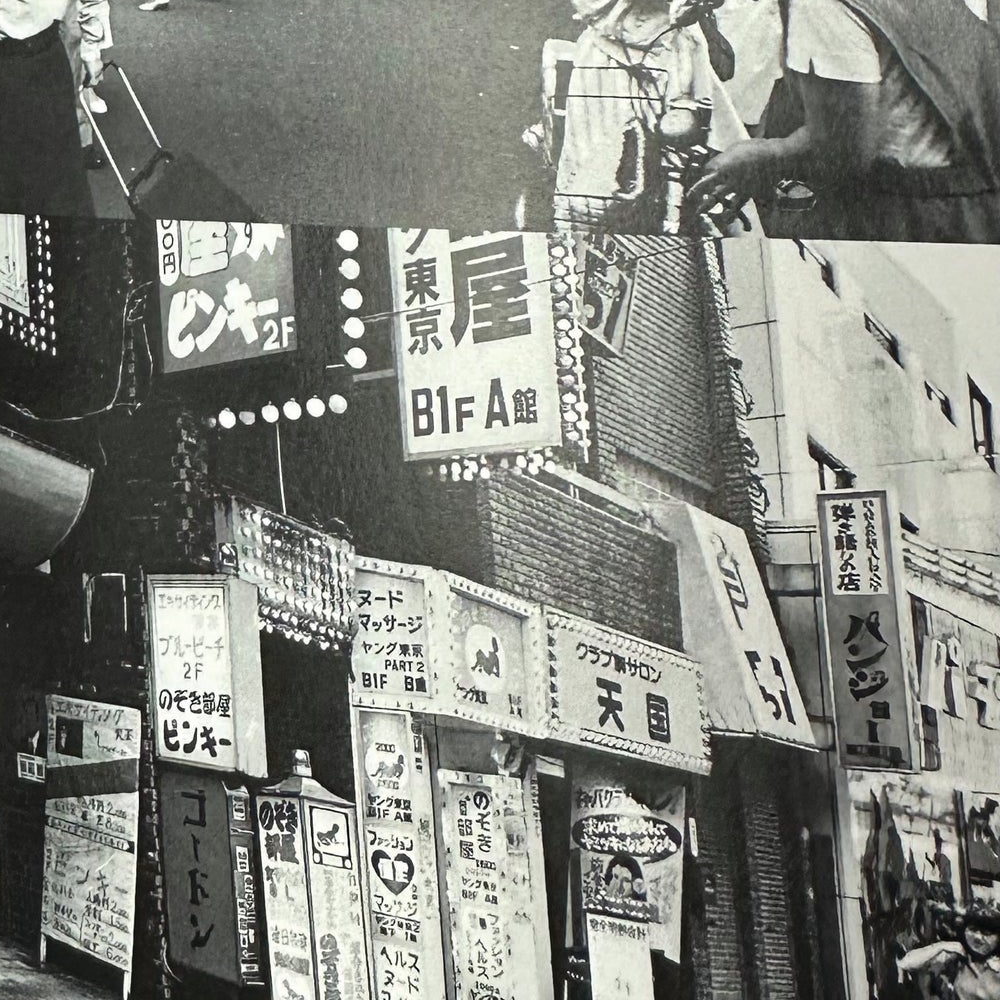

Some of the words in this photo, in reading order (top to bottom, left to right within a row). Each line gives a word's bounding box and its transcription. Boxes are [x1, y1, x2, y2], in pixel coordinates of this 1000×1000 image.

[263, 316, 295, 350] 2F
[831, 503, 860, 592] 弾き語りの店
[357, 590, 403, 609] ヌード
[358, 614, 423, 634] マッサージ
[362, 641, 424, 658] ヤング東京
[183, 662, 204, 681] 2F
[384, 659, 414, 675] PART
[416, 660, 426, 673] 2
[158, 688, 231, 718] のぞき部屋
[596, 677, 671, 743] 天国
[163, 719, 232, 758] ピンキー
[473, 791, 493, 853] のぞき
[380, 946, 420, 972] ヘルス
